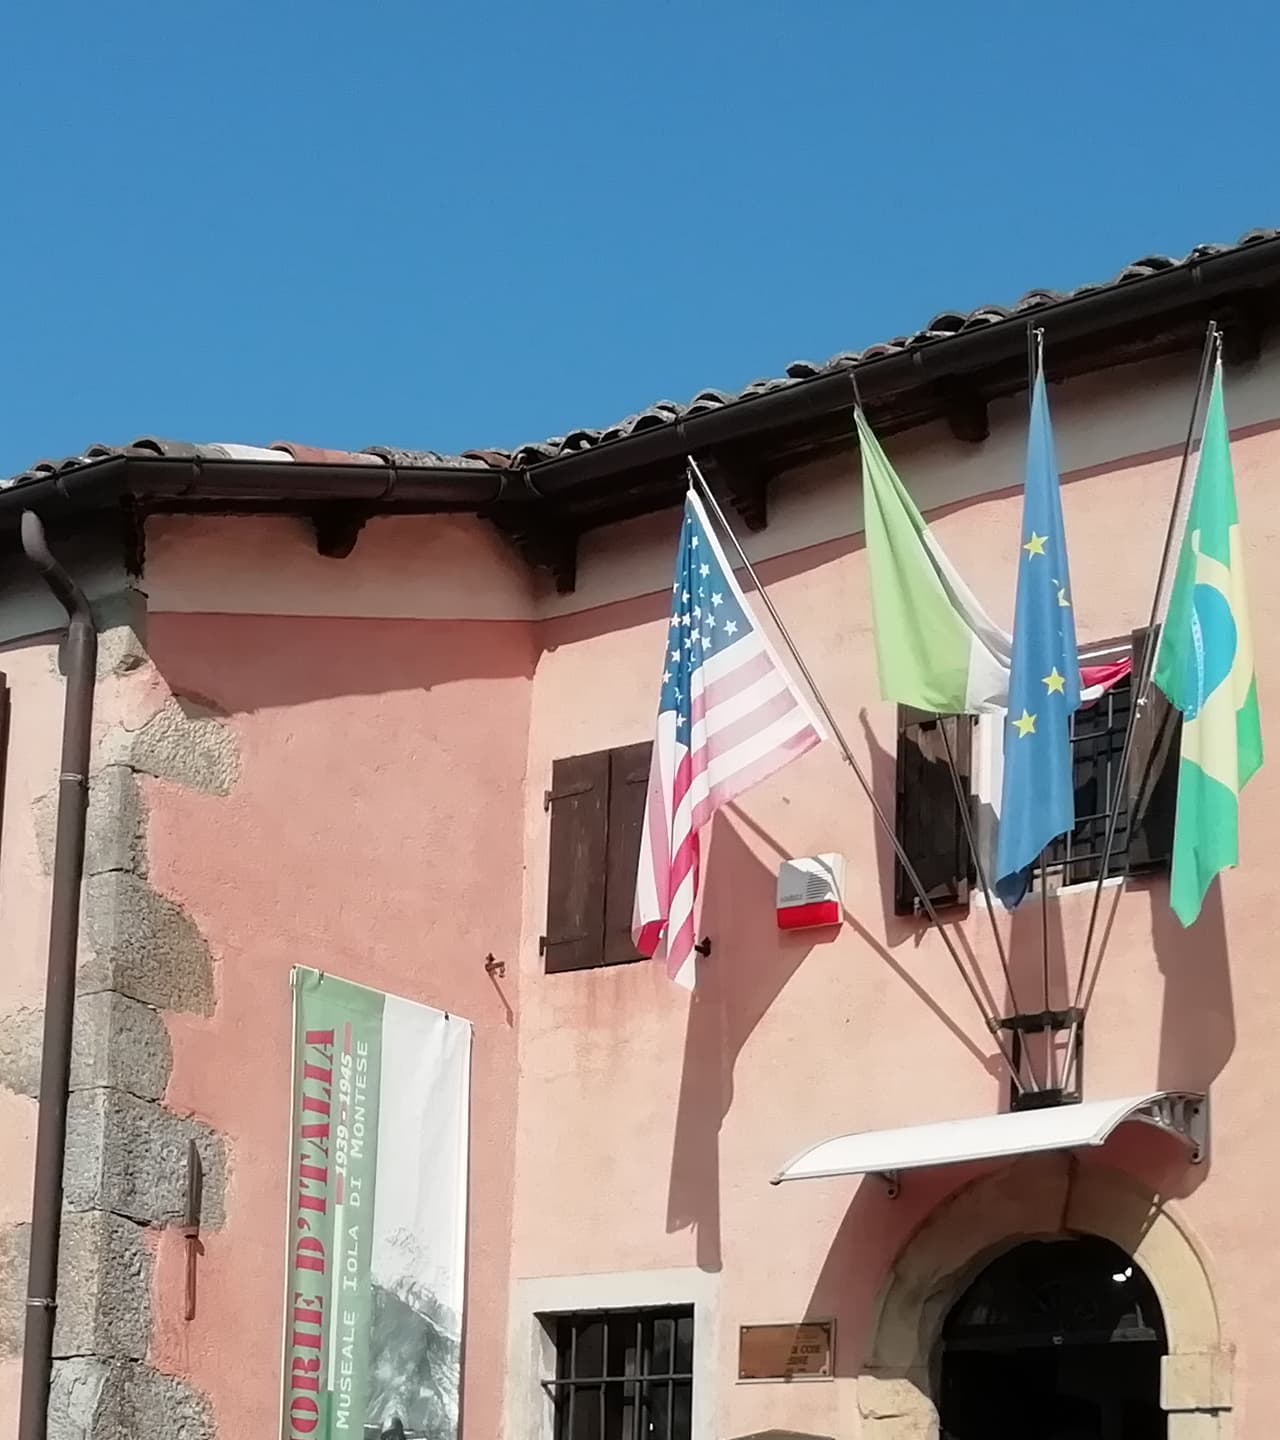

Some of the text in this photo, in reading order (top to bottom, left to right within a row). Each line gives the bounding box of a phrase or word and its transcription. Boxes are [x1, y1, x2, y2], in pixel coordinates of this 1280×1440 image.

[338, 1052, 353, 1105] 1945
[350, 1040, 368, 1158] MONTESE
[335, 1126, 350, 1177] 1939
[349, 1176, 362, 1207] DI
[342, 1224, 360, 1292] IOLA
[336, 1311, 356, 1429] MUSEALE
